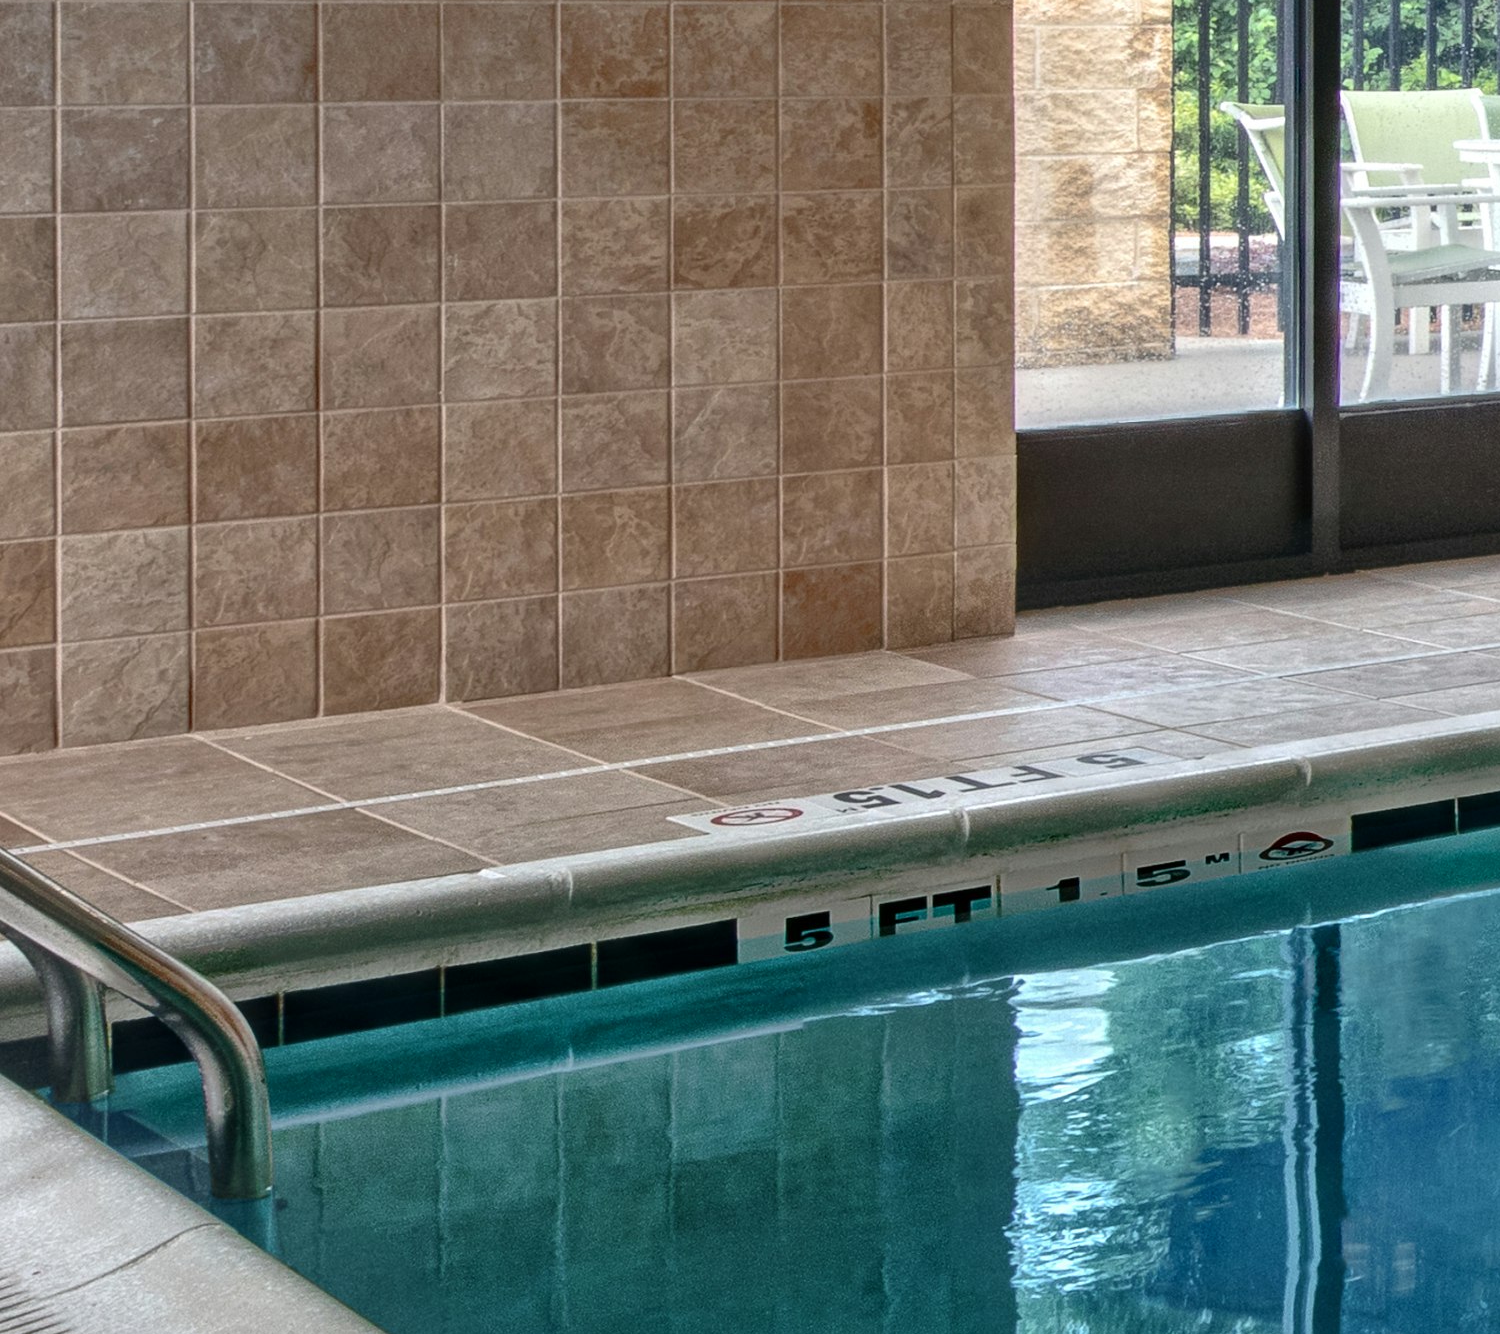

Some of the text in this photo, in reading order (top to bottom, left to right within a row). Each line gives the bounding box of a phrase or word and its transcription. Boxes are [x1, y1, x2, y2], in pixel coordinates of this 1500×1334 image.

[1076, 754, 1147, 768] 5
[946, 766, 1066, 793] FT
[784, 911, 834, 953] 5
[879, 885, 993, 937] FT
[1205, 853, 1230, 865] M
